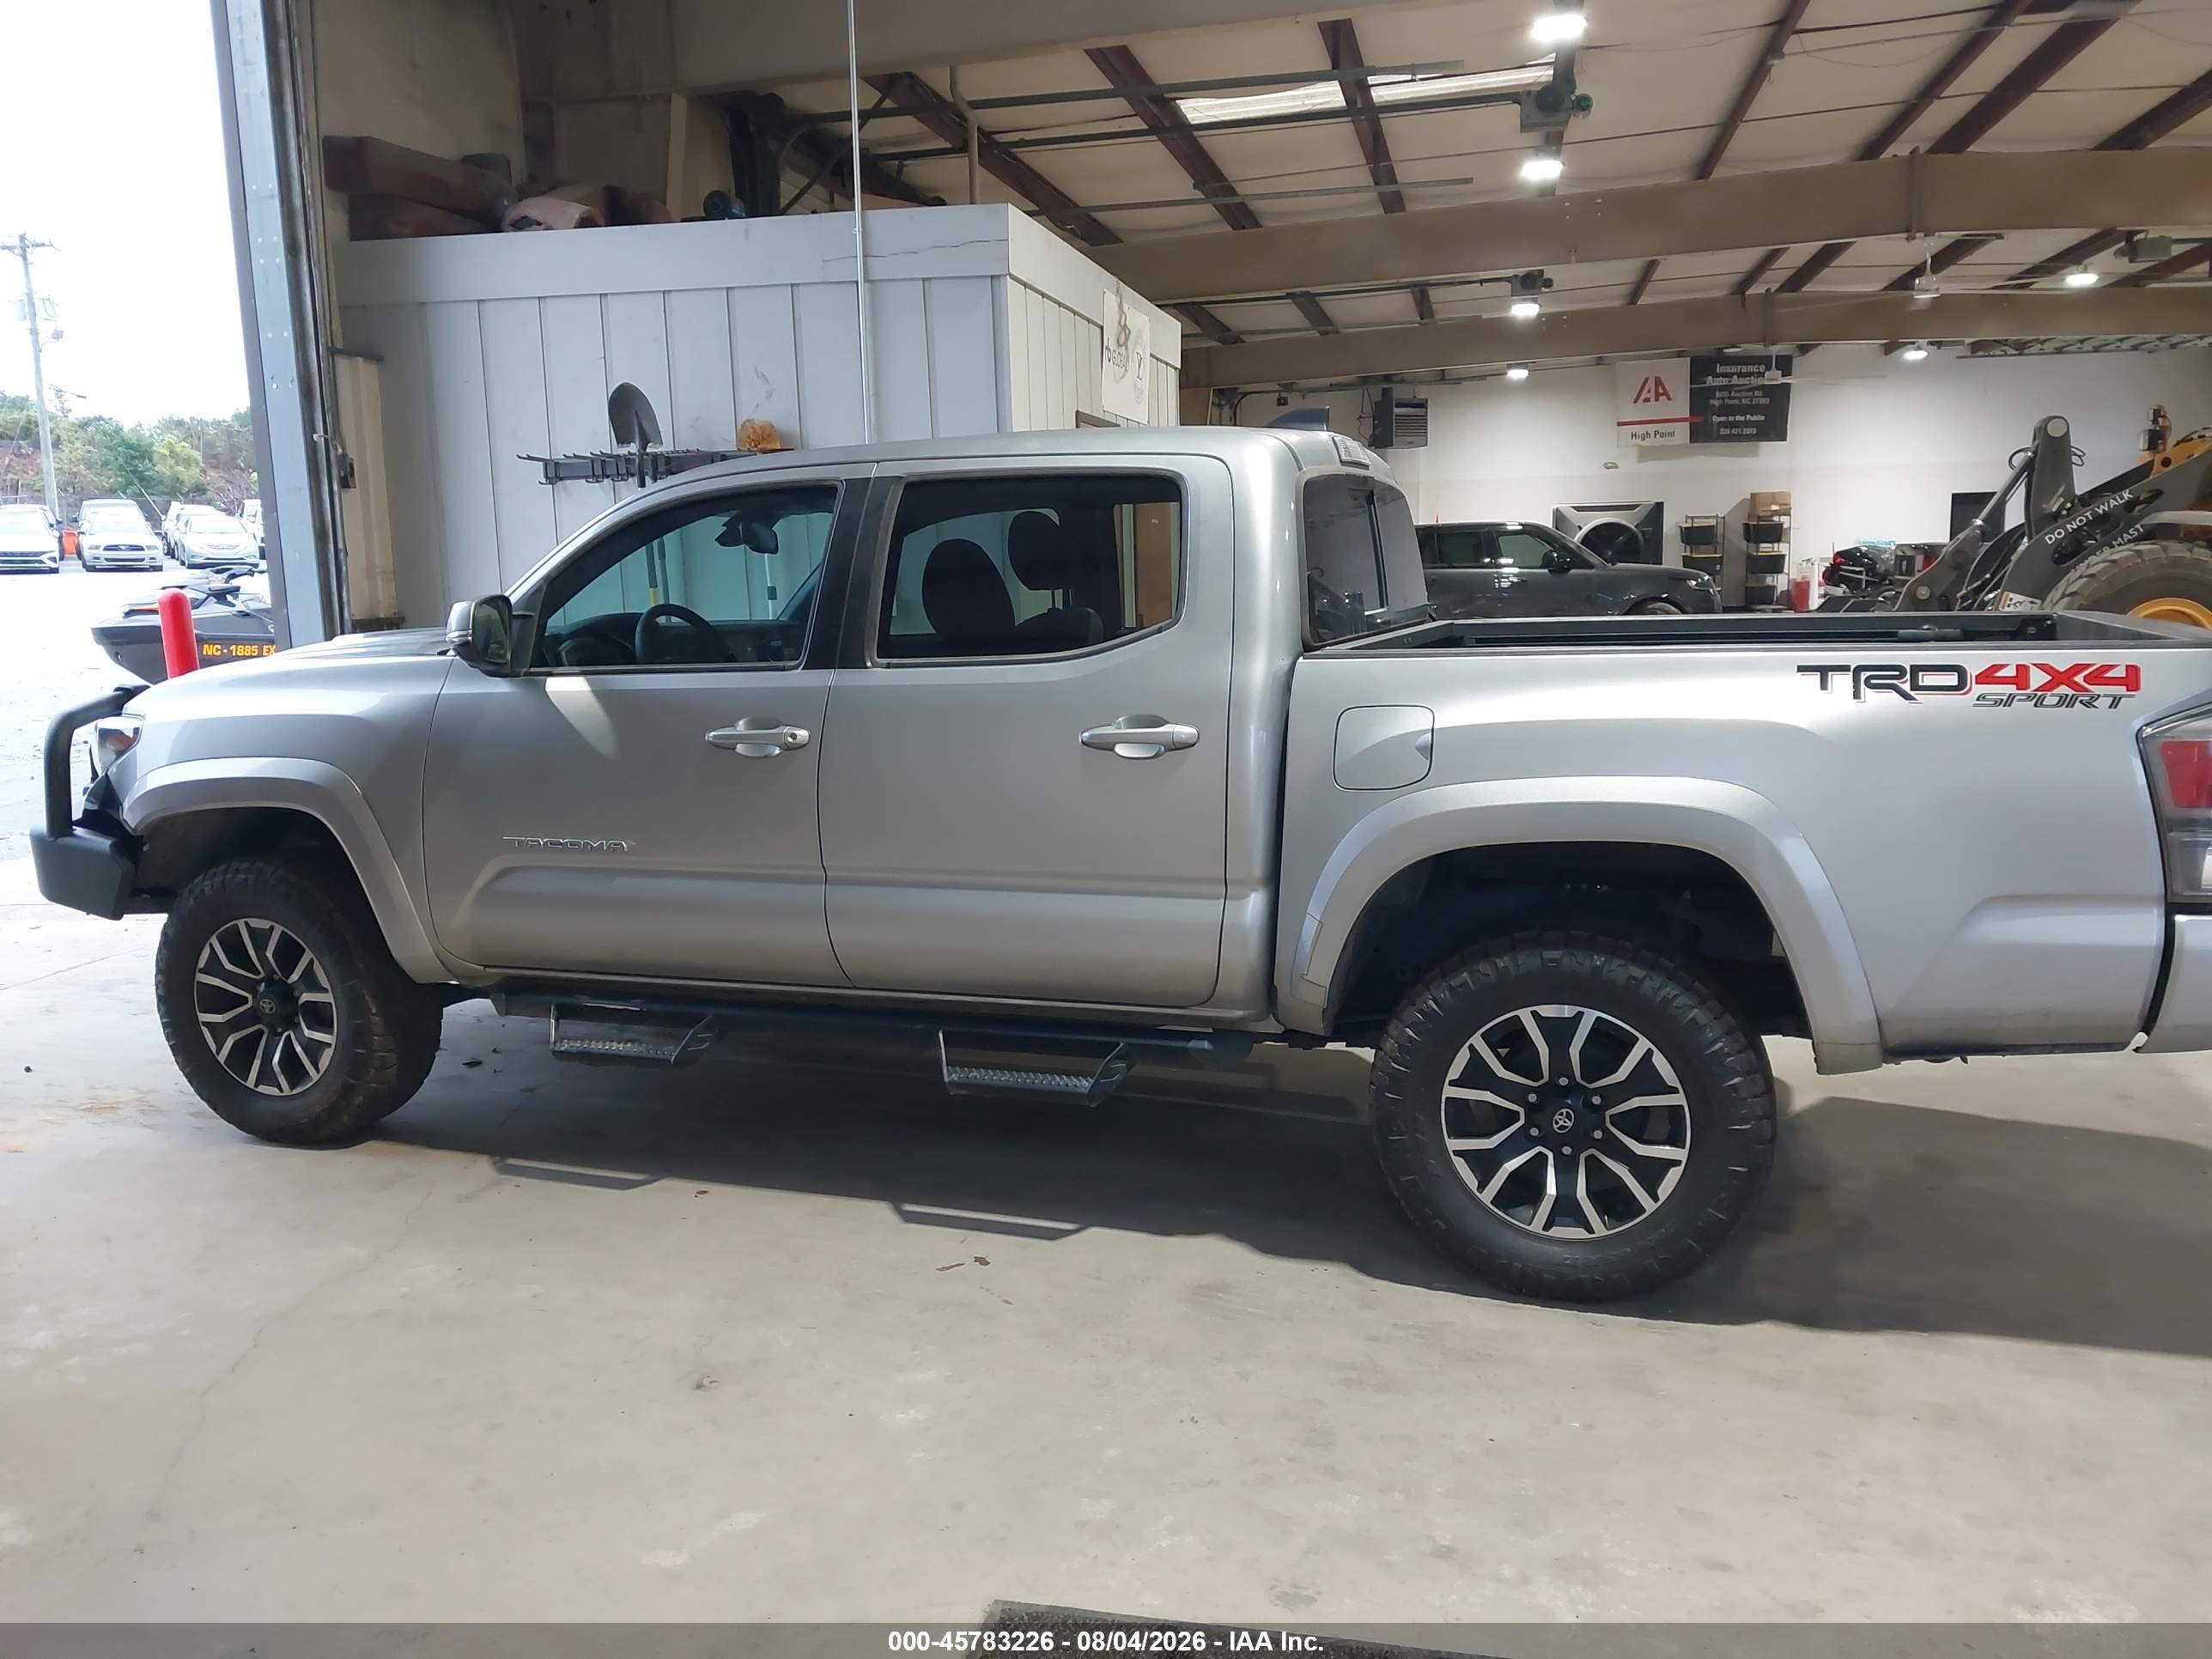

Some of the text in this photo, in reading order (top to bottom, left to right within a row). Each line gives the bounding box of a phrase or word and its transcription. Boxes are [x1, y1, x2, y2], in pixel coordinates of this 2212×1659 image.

[1717, 363, 1765, 374] Insurance
[1631, 429, 1676, 441] High Point
[2045, 489, 2134, 545] DO NOT WALK
[2112, 524, 2145, 548] MAST
[203, 644, 222, 655] NC
[229, 645, 259, 656] 1885
[263, 645, 276, 655] EX
[1796, 663, 2142, 703] TRD 4X4
[1971, 692, 2136, 709] SPORT
[501, 836, 629, 853] TACOMA
